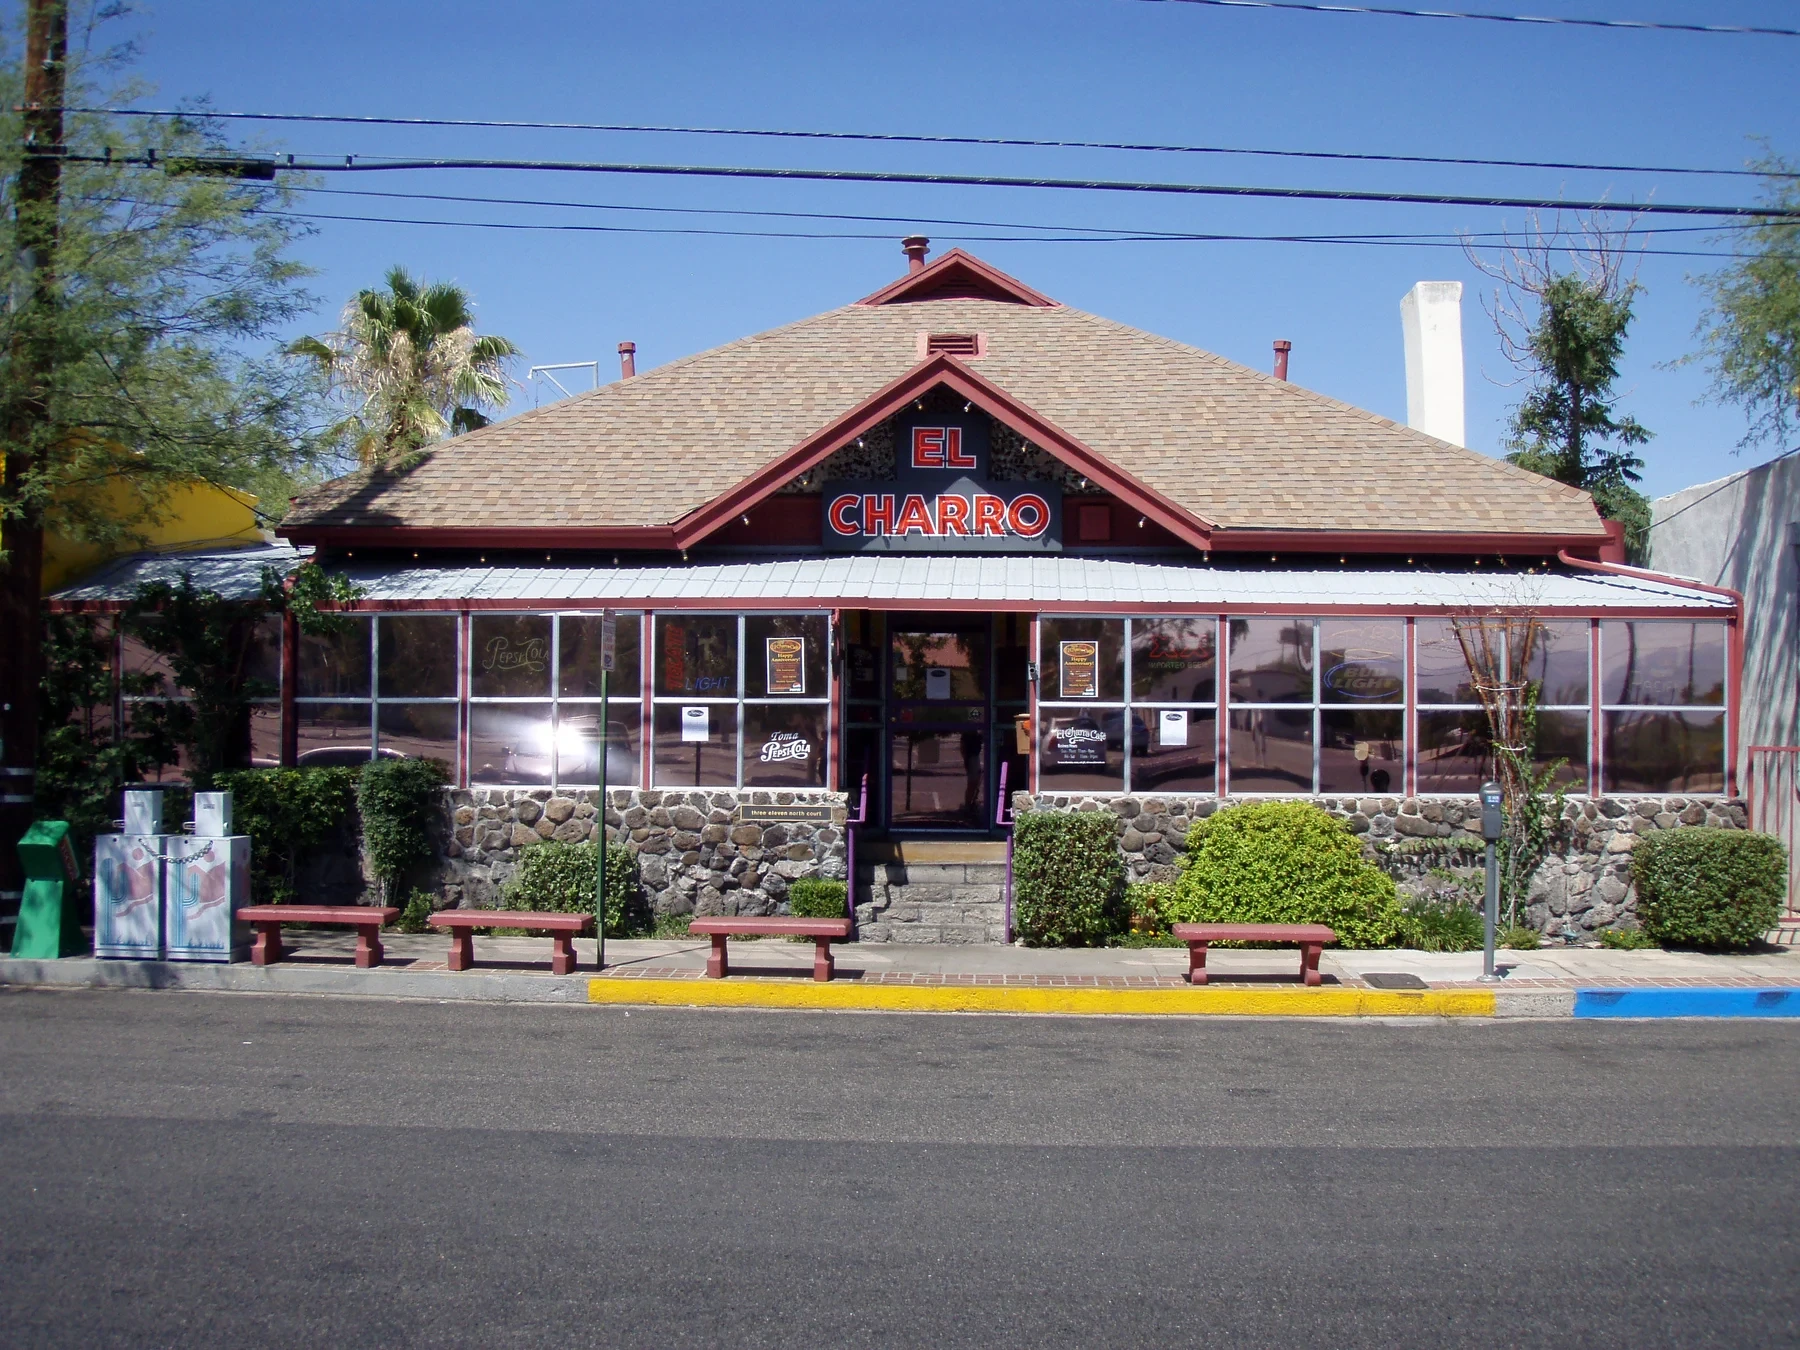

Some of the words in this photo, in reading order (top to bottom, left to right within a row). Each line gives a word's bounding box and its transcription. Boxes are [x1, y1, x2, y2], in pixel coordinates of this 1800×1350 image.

[911, 426, 976, 468] EL
[828, 493, 1051, 538] CHARRO
[1344, 667, 1388, 679] BUD
[685, 676, 730, 691] LIGHT
[1333, 679, 1397, 689] LIGHT
[771, 731, 799, 741] Toma
[1056, 729, 1065, 739] El
[760, 739, 811, 762] PEPSI-COLA
